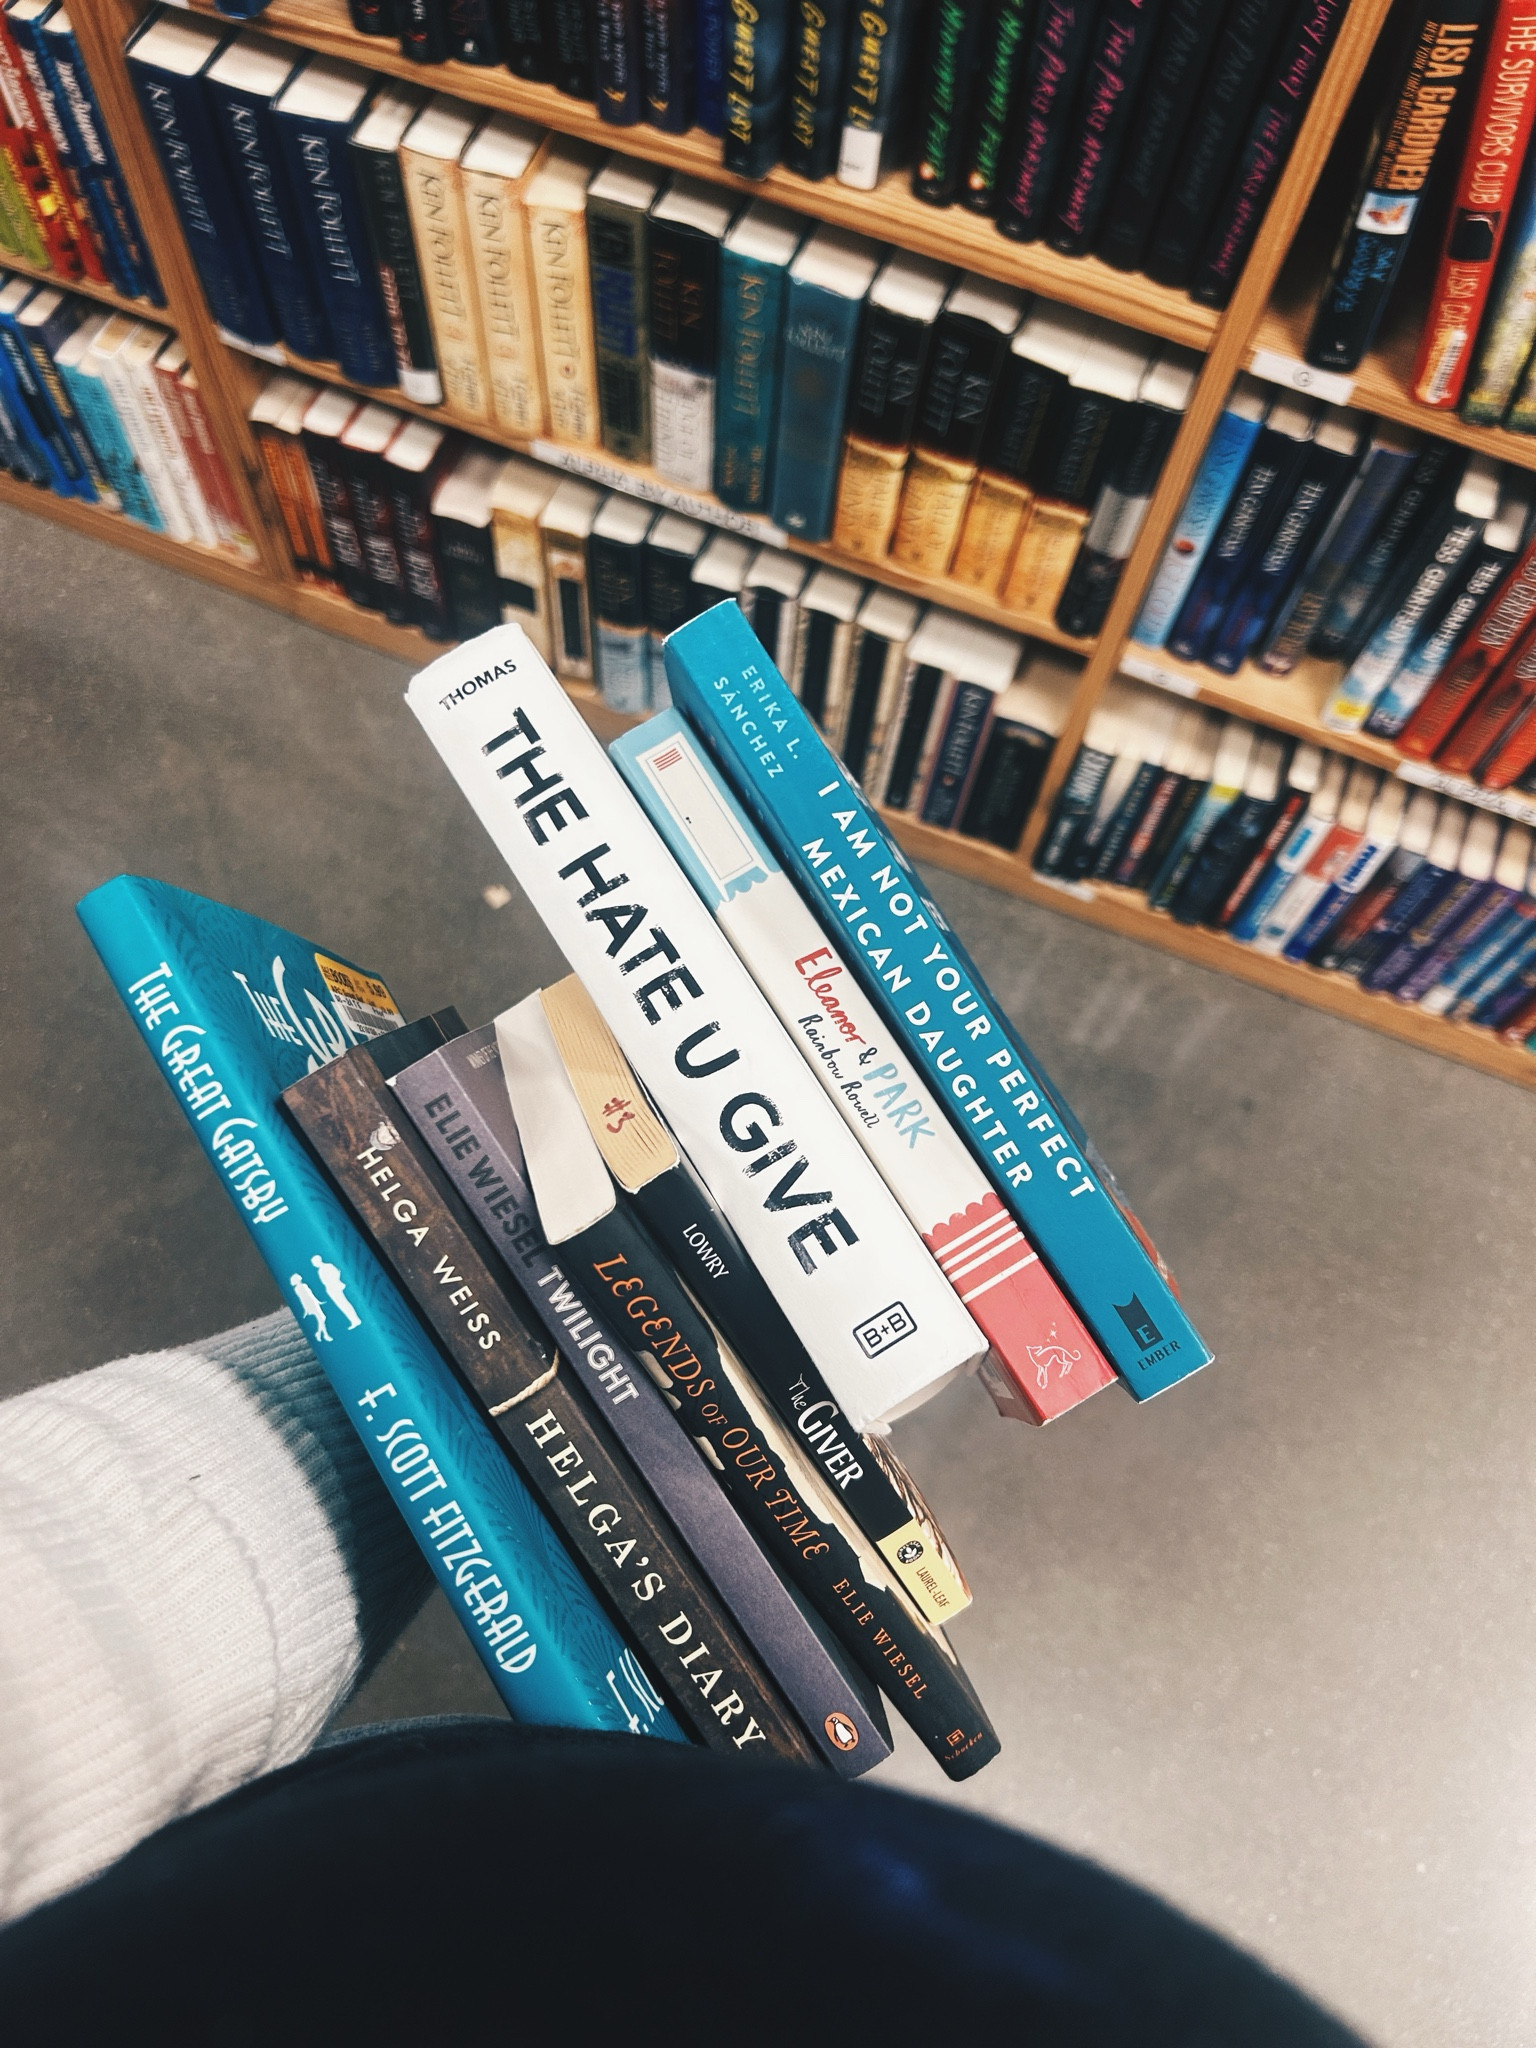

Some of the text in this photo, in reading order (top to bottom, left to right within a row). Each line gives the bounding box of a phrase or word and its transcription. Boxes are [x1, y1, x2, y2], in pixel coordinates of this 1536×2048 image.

[850, 8, 888, 104] GUEST
[1386, 24, 1479, 191] LISA GARDNER
[1468, 15, 1536, 205] THE SURVIVORS CLUB
[1446, 265, 1483, 300] LISA
[438, 658, 518, 712] THOMAS
[713, 675, 785, 779] SÁNCHEZ
[741, 664, 802, 760] ERIKA L.
[481, 706, 861, 1277] THE HATE U GIVE
[794, 946, 938, 1150] Eleanor & PARK
[801, 837, 1034, 1190] MEXICAN DAUGHTER
[817, 779, 1097, 1199] I AM NOT YOUR PERFECT
[796, 1012, 882, 1131] Rainbow Rowell
[355, 1145, 502, 1351] HELGA WEISS
[422, 1090, 482, 1162] ELIE
[467, 1153, 546, 1270] WIESEL
[535, 1263, 641, 1408] TWILIGHT
[681, 1222, 730, 1281] LOWRY
[127, 961, 539, 1676] THE GREAT GATSBY F. SCOTT FITZGERALD
[862, 1312, 909, 1350] B+B
[1136, 1338, 1182, 1372] EMBER
[592, 1252, 831, 1562] LEGENDS OF OUR TIME
[796, 1399, 866, 1492] GIVER
[524, 1406, 668, 1602] HELGA'S
[657, 1610, 767, 1751] DIARY
[831, 1576, 876, 1628] ELIE
[870, 1626, 929, 1702] WIESEL
[914, 1564, 952, 1611] LAUREL-LEAF
